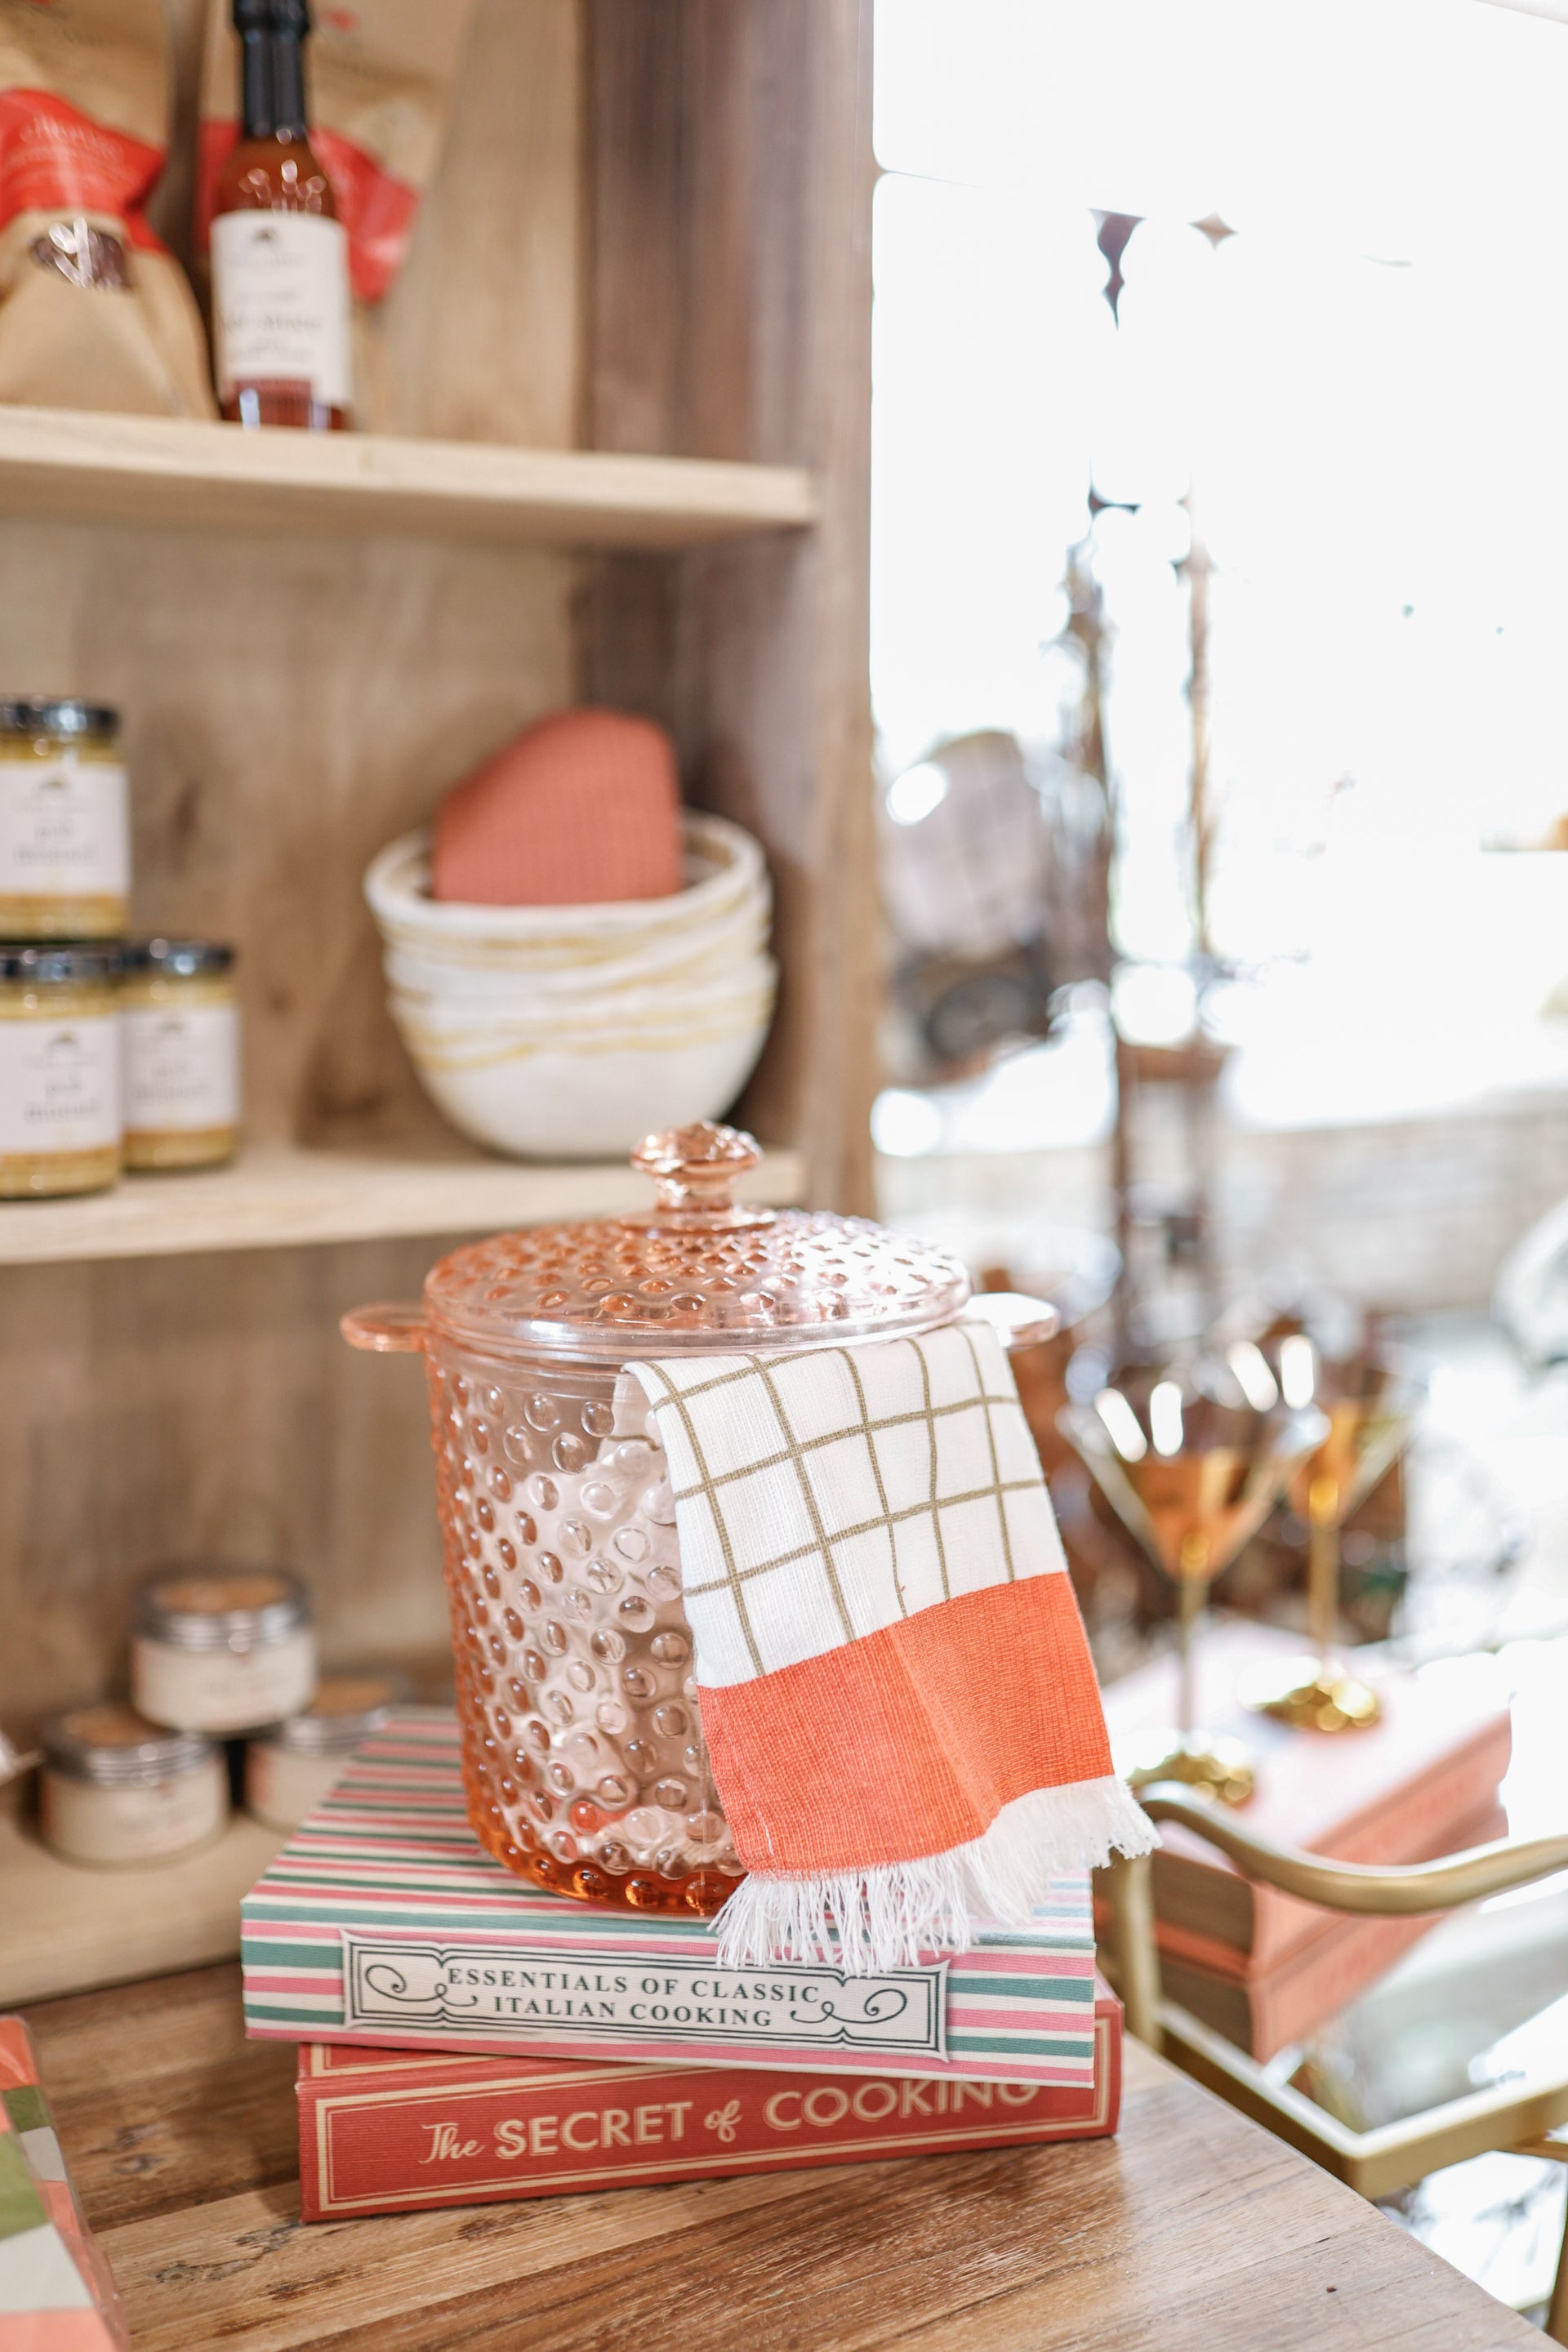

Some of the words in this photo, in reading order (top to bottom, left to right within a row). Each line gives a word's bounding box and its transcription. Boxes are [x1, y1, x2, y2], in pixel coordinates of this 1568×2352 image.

[448, 1968, 627, 1993] ESSENTIALS
[641, 1978, 677, 1995] OF
[692, 1980, 818, 2003] CLASSIC
[493, 1996, 616, 2018] ITALIAN
[630, 2003, 771, 2027] COOKING
[418, 2122, 486, 2164] The
[493, 2100, 693, 2159] SECRET
[703, 2100, 742, 2143] of
